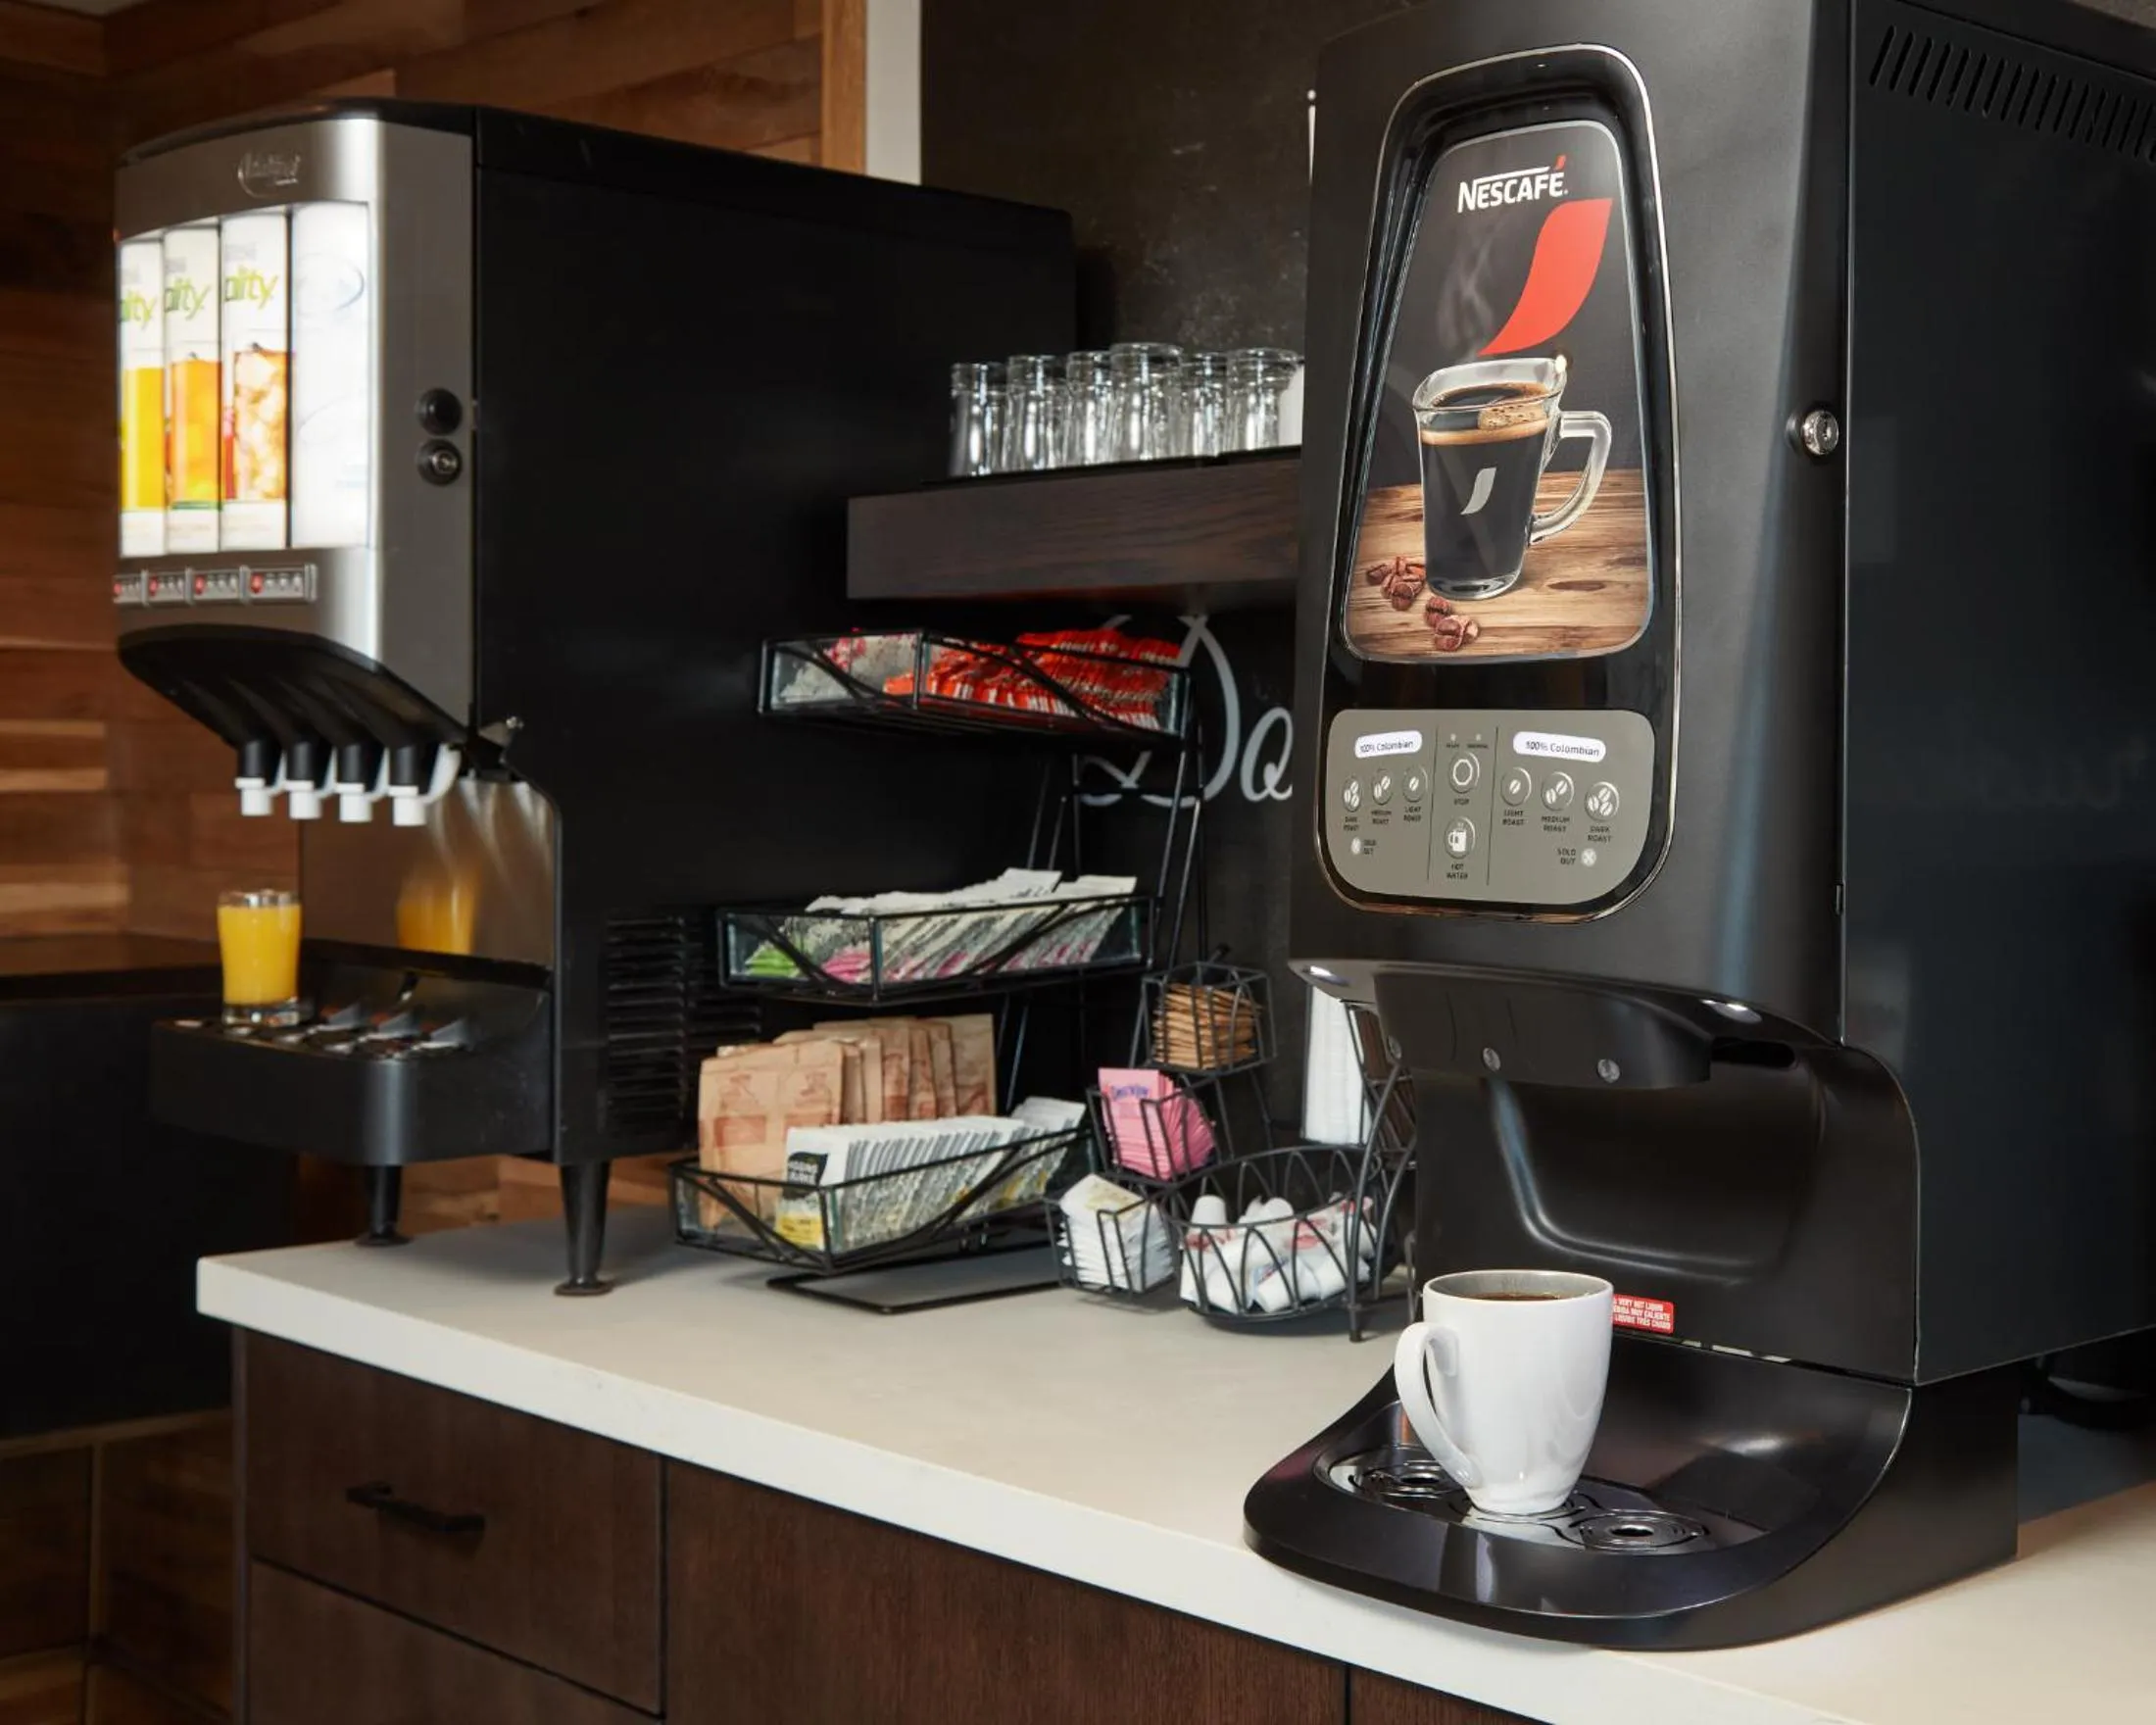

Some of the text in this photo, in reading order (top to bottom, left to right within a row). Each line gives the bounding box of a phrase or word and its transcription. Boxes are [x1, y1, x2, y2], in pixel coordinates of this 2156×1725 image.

[1376, 740, 1414, 752] Colombian
[1525, 740, 1599, 757] 100% Colombian
[1587, 834, 1612, 843] ROAST
